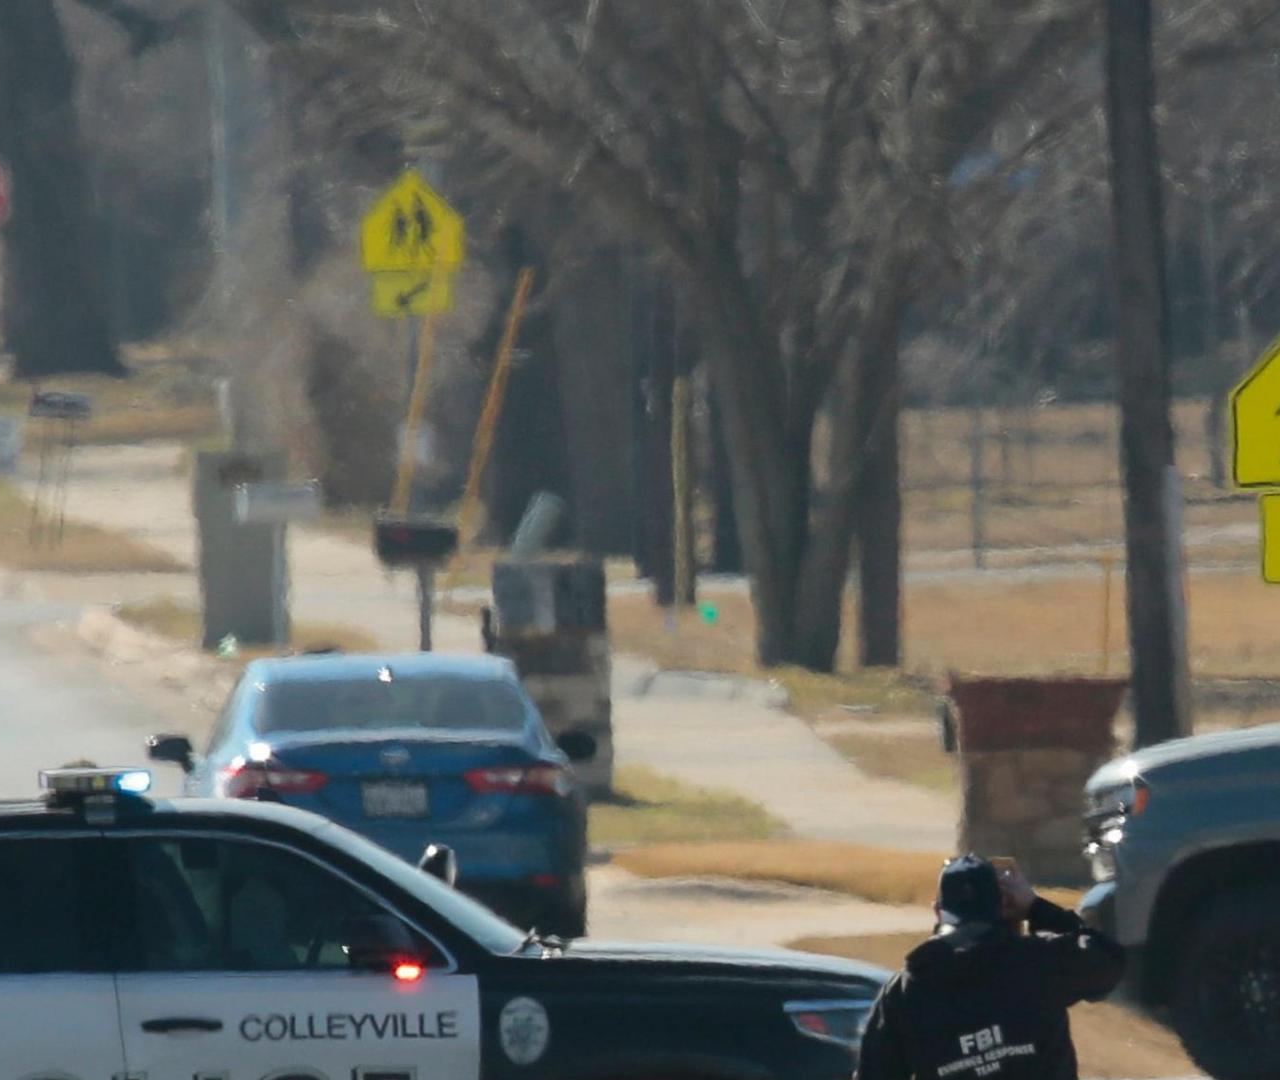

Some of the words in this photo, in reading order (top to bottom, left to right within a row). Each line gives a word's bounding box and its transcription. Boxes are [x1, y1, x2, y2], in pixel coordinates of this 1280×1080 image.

[239, 1011, 459, 1042] COLLEYVILLE
[959, 1024, 1003, 1055] FBI
[975, 1060, 1001, 1077] TEAM
